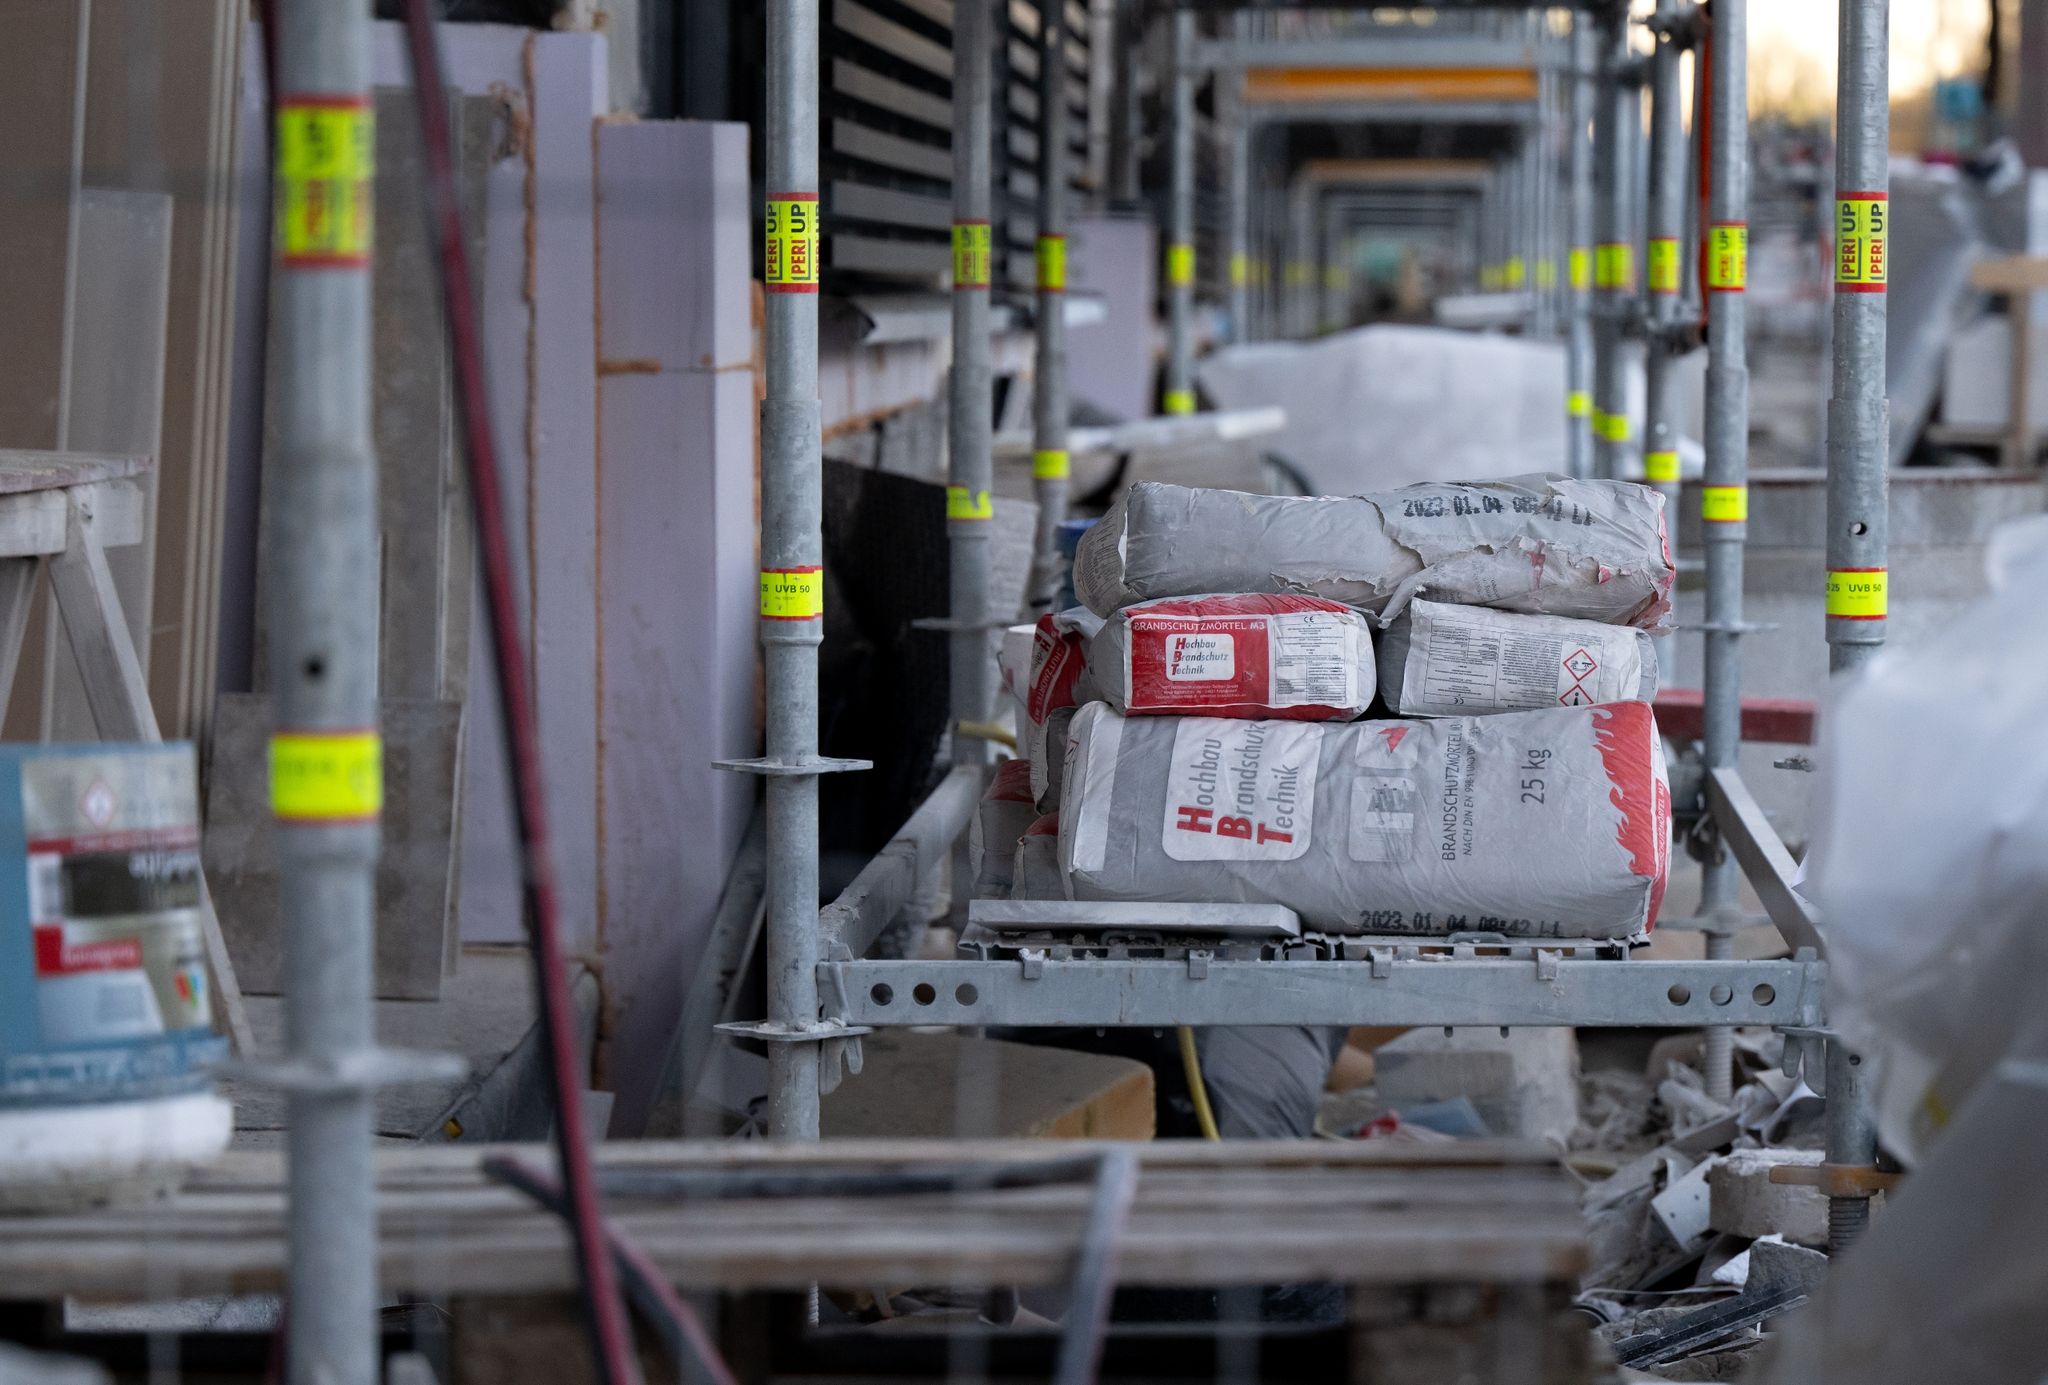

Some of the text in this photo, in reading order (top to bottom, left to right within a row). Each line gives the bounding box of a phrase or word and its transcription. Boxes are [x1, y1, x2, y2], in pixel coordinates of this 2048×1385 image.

[767, 203, 777, 274] PERI UP
[791, 203, 806, 274] PERI UP
[1841, 203, 1856, 274] PERI UP
[1870, 203, 1883, 274] PERI UP
[775, 584, 797, 593] UVB
[800, 585, 810, 593] 50
[1848, 583, 1870, 593] UVB
[1872, 583, 1882, 592] 50
[1133, 620, 1265, 631] BRANDSCHUTZMÖRTEL M3
[1175, 637, 1217, 650] Hochbau
[1172, 650, 1230, 663] Brandschutz
[1171, 663, 1205, 676] Technik
[1176, 738, 1222, 834] Hochbau
[1216, 722, 1267, 840] Brandschutz
[1464, 773, 1475, 793] 998-1
[1520, 748, 1553, 805] 25 kg
[1256, 763, 1300, 845] Technik
[1441, 732, 1463, 861] BRANDSCHUTZMÖRTEL
[1463, 795, 1474, 808] EN
[1463, 810, 1473, 827] DIN
[1462, 828, 1473, 857] NACH
[1478, 914, 1532, 935] 08:42
